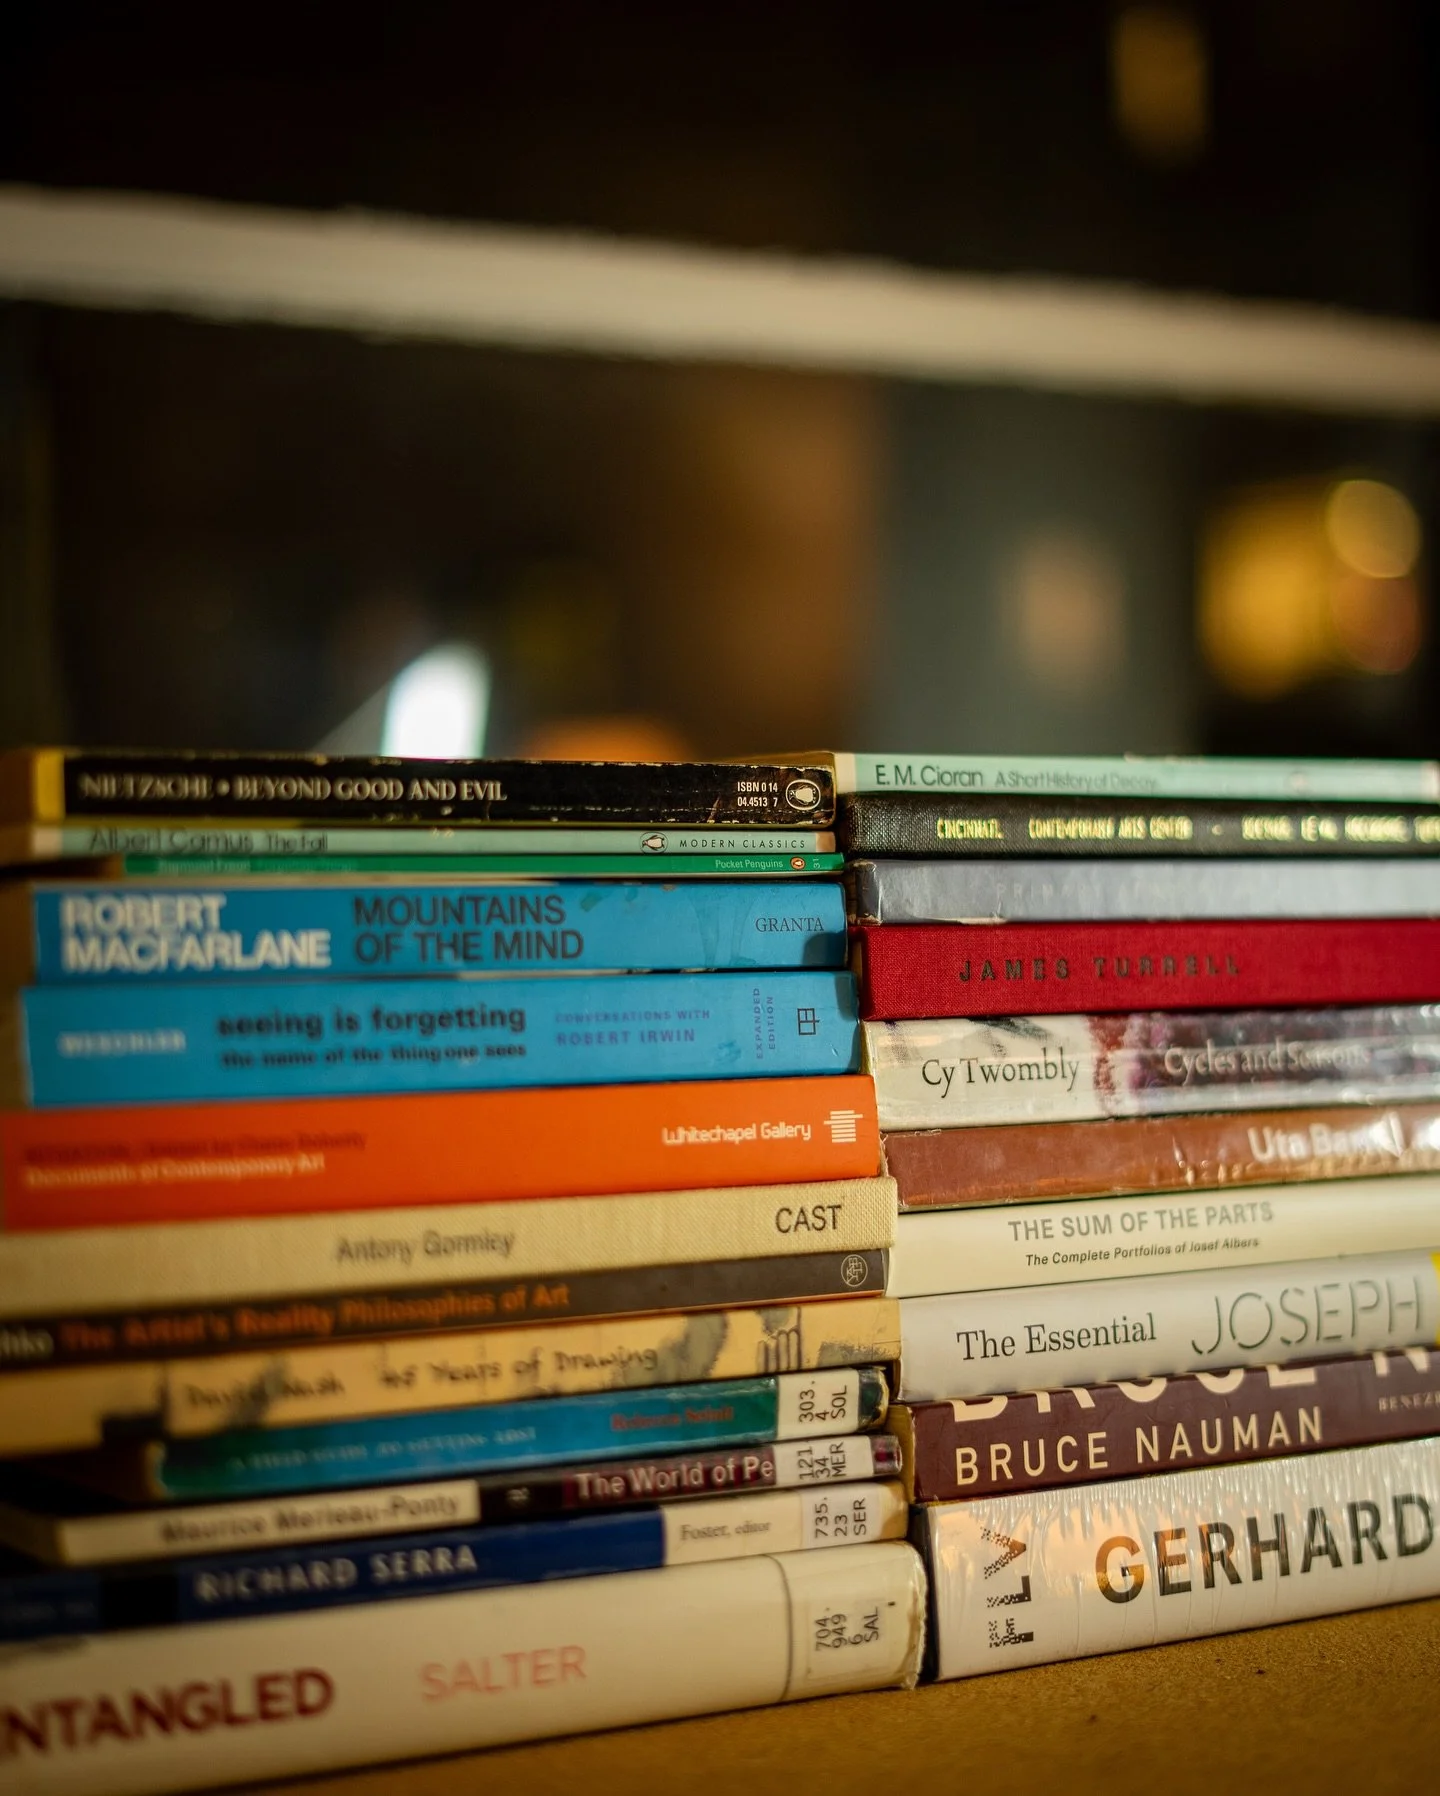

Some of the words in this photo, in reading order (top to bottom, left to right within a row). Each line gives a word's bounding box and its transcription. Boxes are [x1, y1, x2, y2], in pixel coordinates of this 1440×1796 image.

[234, 775, 331, 799] BEYOND
[336, 777, 403, 800] GOOD
[409, 780, 456, 800] AND
[461, 780, 506, 801] EVIL
[737, 781, 759, 792] ISBN
[769, 781, 778, 792] 14
[920, 765, 983, 786] Cioran
[994, 772, 1006, 787] A
[1009, 771, 1045, 789] Short
[773, 797, 778, 807] 7
[90, 827, 162, 851] Albert
[169, 828, 254, 852] Camus
[266, 831, 298, 852] The
[680, 839, 735, 849] MODERN
[742, 839, 805, 848] CLASSICS
[715, 859, 744, 869] Pocket
[745, 859, 783, 869] Penguins
[61, 894, 226, 931] ROBERT
[354, 894, 566, 926] MOUNTAINS
[755, 916, 825, 932] GRANTA
[63, 929, 331, 972] MACFARLANE
[355, 931, 402, 963] OF
[414, 931, 482, 961] THE
[494, 929, 584, 960] MIND
[959, 957, 1071, 982] JAMES
[1093, 955, 1240, 977] TURRELL
[217, 1008, 323, 1039] seeing
[333, 1006, 360, 1033] is
[372, 1003, 526, 1036] forgetting
[677, 1009, 711, 1020] WITH
[752, 987, 764, 1060] EXPANDED
[767, 996, 777, 1051] EDITION
[556, 1030, 631, 1046] ROBERT
[640, 1028, 696, 1044] IRWIN
[921, 1058, 956, 1098] Cy
[964, 1046, 1080, 1092] Twombly
[1165, 1038, 1237, 1087] Cycles
[1241, 1036, 1283, 1073] and
[760, 1121, 811, 1141] Gallery
[774, 1204, 843, 1234] CAST
[1008, 1217, 1054, 1242] THE
[1062, 1213, 1113, 1239] SUM
[1120, 1211, 1151, 1234] OF
[1154, 1206, 1199, 1230] THE
[1205, 1201, 1275, 1227] PARTS
[336, 1236, 413, 1266] Antony
[423, 1227, 516, 1259] Gormley
[1026, 1253, 1048, 1266] The
[1052, 1250, 1110, 1265] Complete
[1114, 1245, 1171, 1260] Portfolios
[1175, 1243, 1186, 1255] of
[501, 1284, 527, 1311] of
[531, 1282, 570, 1308] Art
[955, 1328, 1016, 1362] The
[1024, 1310, 1158, 1356] Essential
[1190, 1275, 1423, 1356] JOSEPH
[815, 1409, 830, 1422] 4
[831, 1384, 848, 1419] SOL
[829, 1441, 847, 1478] MER
[955, 1430, 1109, 1487] BRUCE
[1135, 1405, 1324, 1465] NAUMAN
[575, 1472, 625, 1498] The
[628, 1462, 704, 1493] World
[711, 1457, 736, 1484] of
[743, 1455, 774, 1480] Pe
[814, 1455, 831, 1479] 34
[834, 1514, 848, 1537] 23
[852, 1497, 866, 1536] SER
[1094, 1492, 1434, 1605] GERHARD
[194, 1557, 358, 1602] RICHARD
[368, 1544, 478, 1580] SERRA
[831, 1613, 848, 1648] 949
[847, 1633, 864, 1645] 6
[863, 1606, 879, 1643] SAL
[419, 1644, 588, 1703] SALTER
